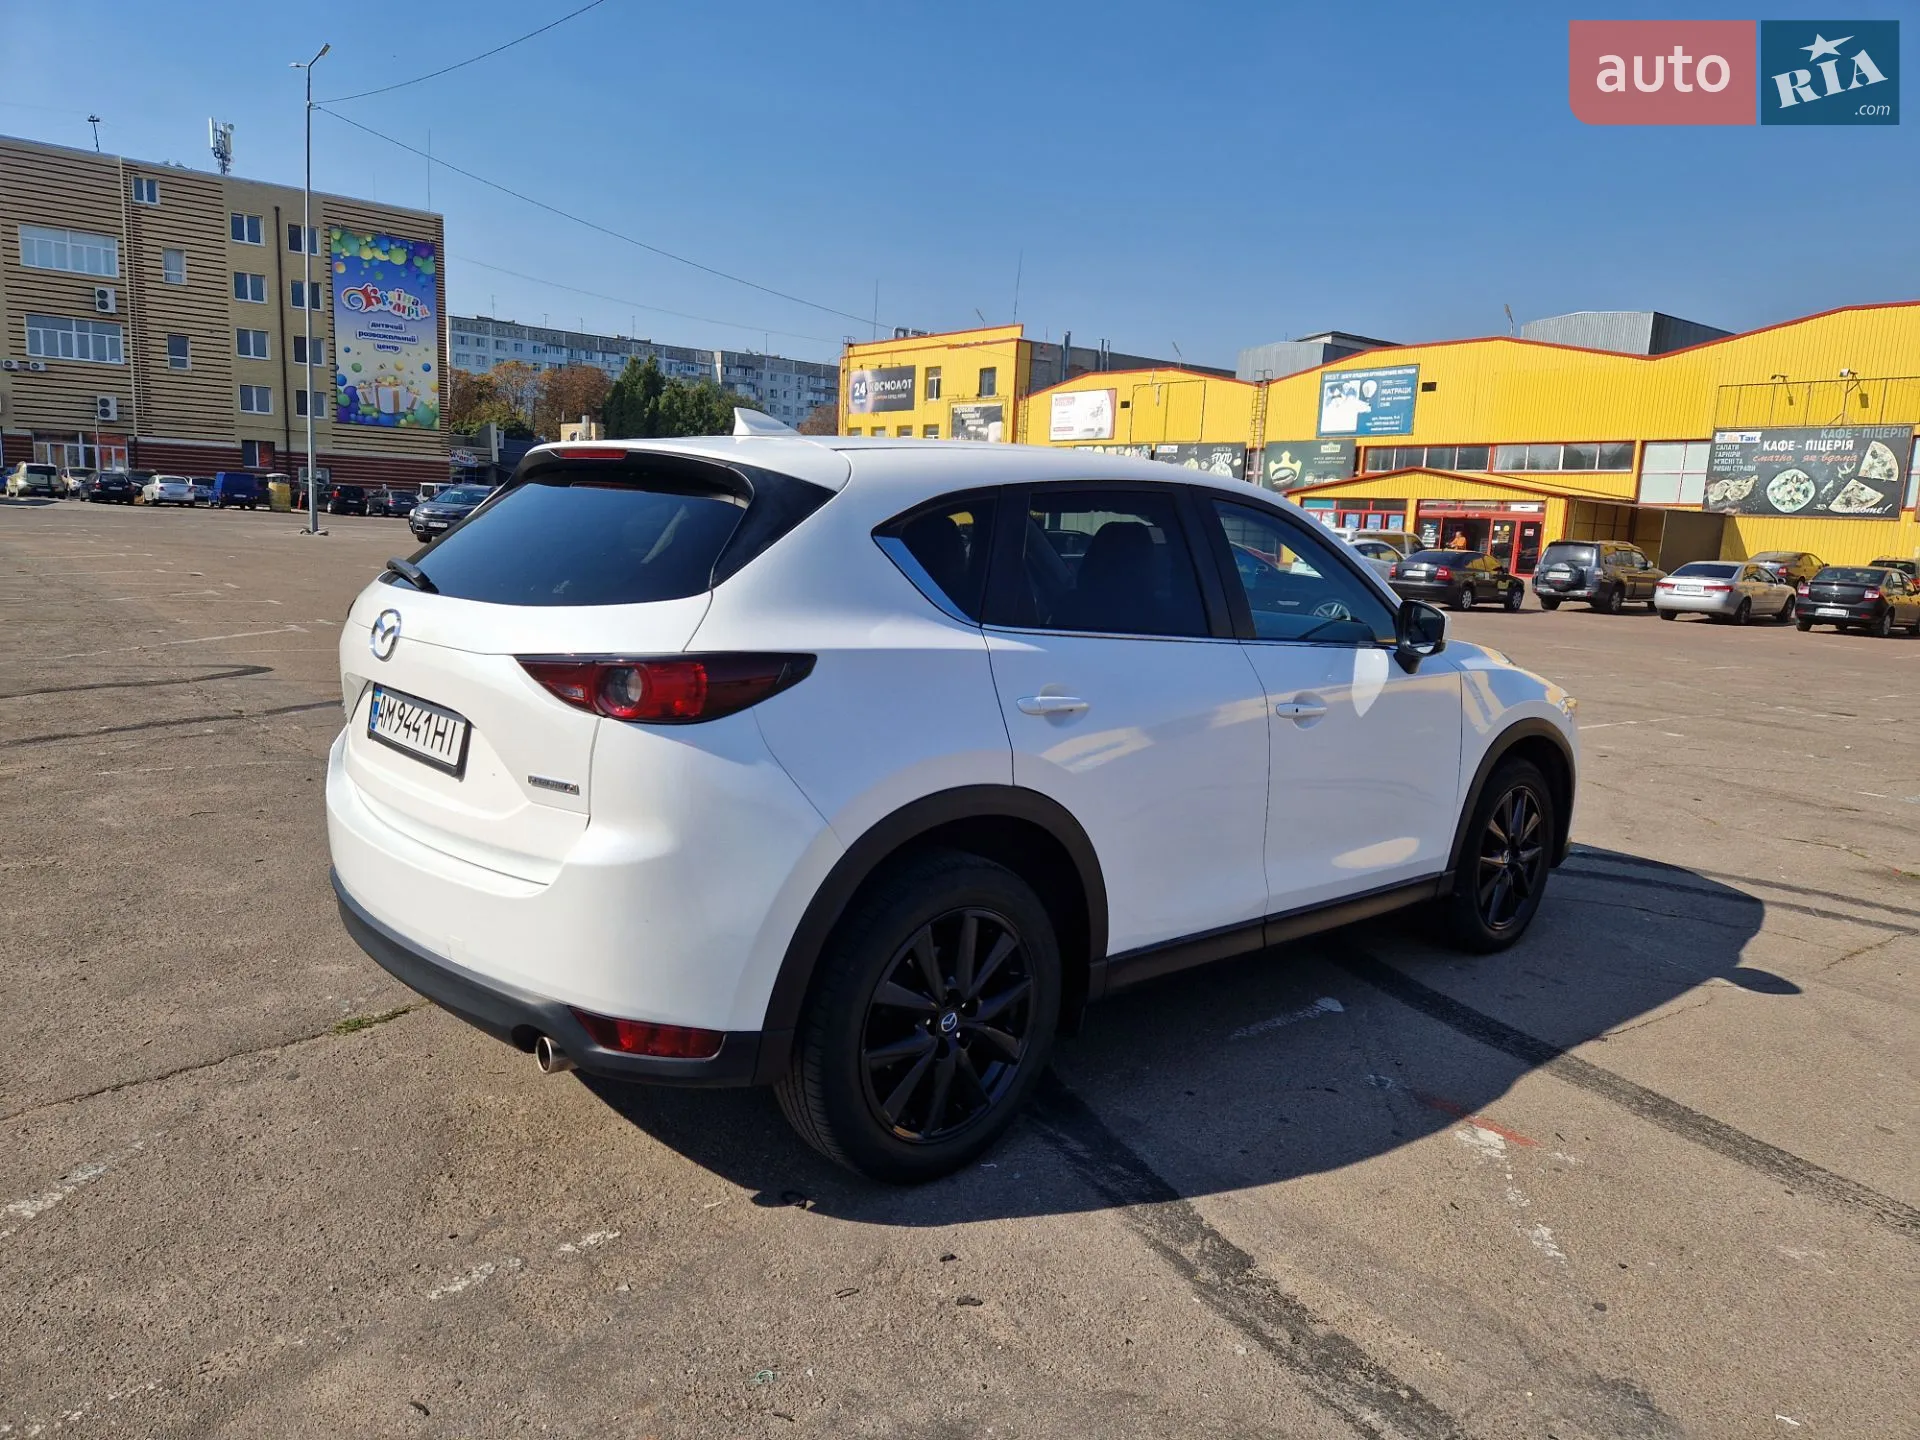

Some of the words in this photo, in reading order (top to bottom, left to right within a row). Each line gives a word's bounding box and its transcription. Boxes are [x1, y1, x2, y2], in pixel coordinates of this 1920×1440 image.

[854, 382, 867, 397] 24
[1820, 429, 1852, 439] КАФЕ
[1862, 428, 1910, 439] ПІЦЕРІЯ
[1762, 440, 1795, 452] КАФЕ
[1805, 439, 1854, 452] ПІЦЕРІЯ
[378, 695, 457, 757] AM9441HI
